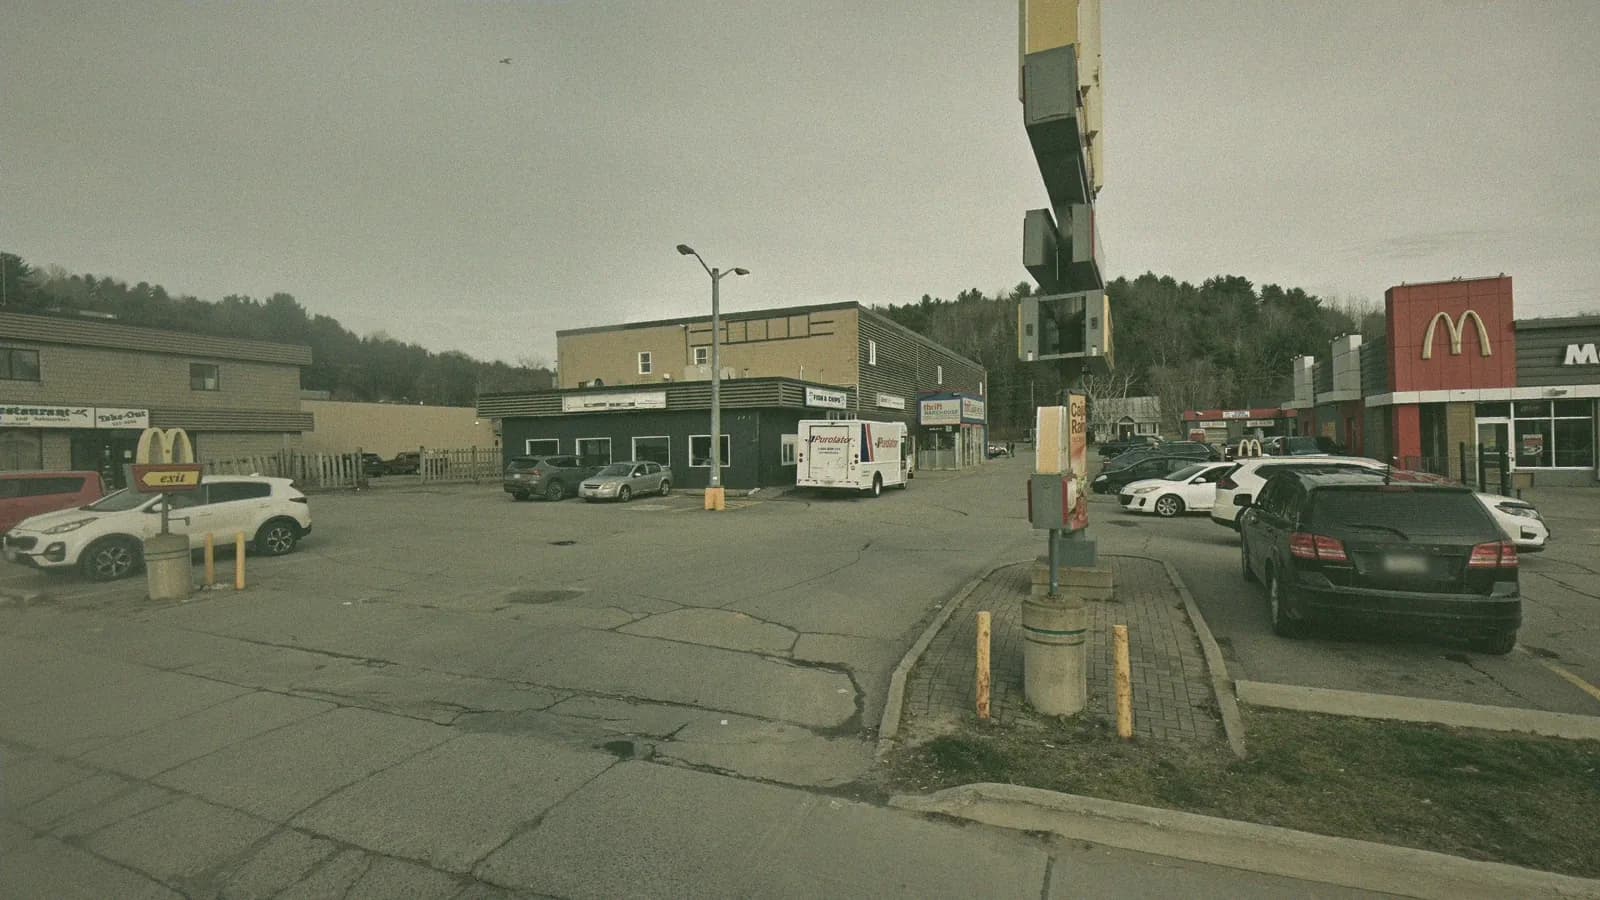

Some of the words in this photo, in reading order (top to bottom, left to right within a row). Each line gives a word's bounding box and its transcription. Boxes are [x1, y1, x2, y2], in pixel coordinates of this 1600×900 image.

[923, 402, 943, 410] thrift
[814, 435, 852, 444] Purolator
[160, 473, 185, 483] exit
